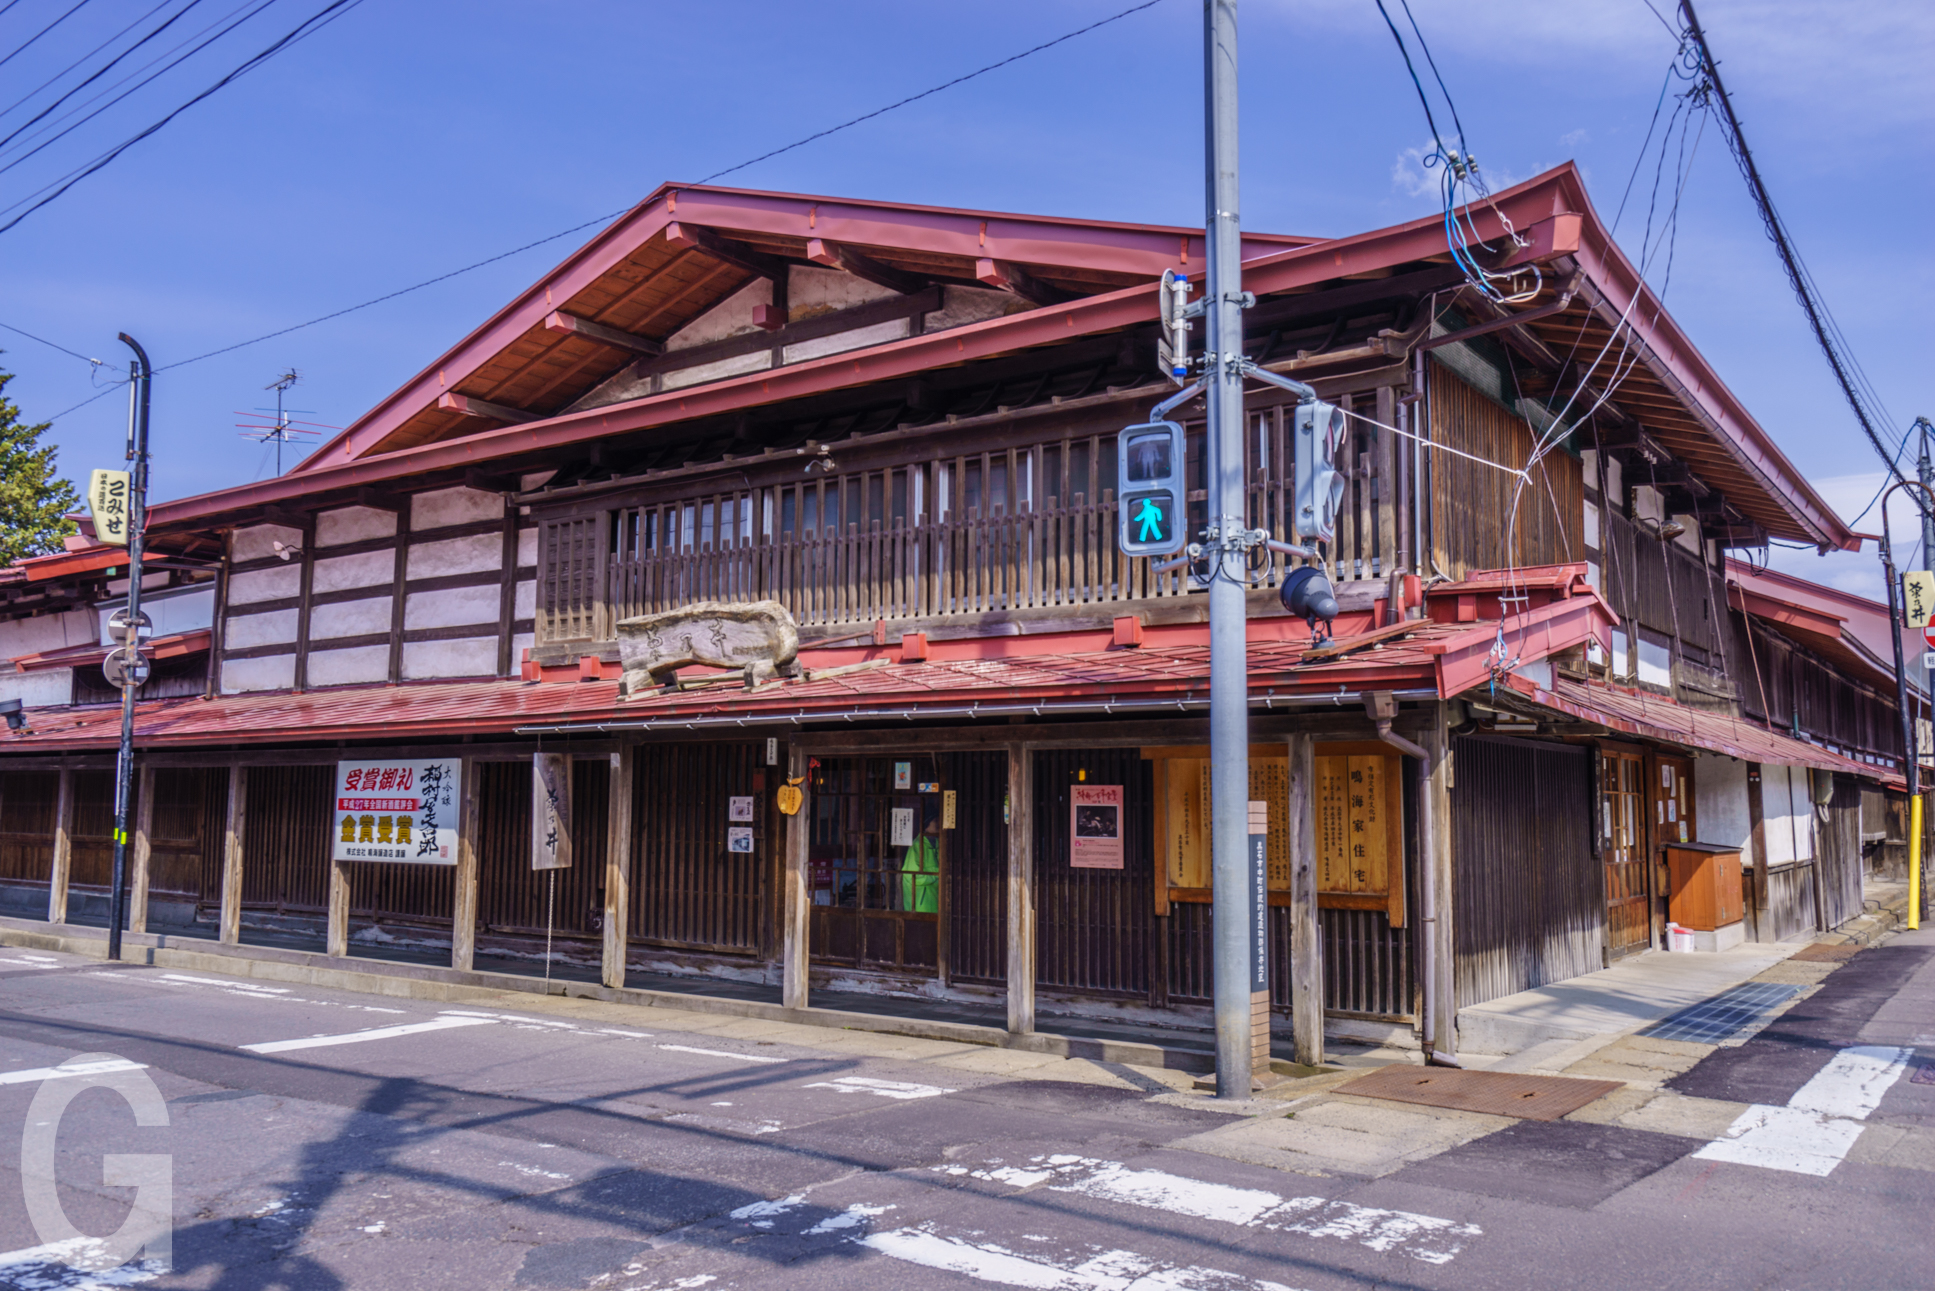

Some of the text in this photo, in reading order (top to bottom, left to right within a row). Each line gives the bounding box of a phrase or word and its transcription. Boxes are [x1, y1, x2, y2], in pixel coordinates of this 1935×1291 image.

[106, 480, 124, 535] こみせ
[1908, 581, 1926, 624] 菊乃井
[344, 767, 414, 791] 受賞御礼
[1367, 765, 1376, 823] 市指定有形文化財
[342, 799, 413, 811] 平成27年全国新酒鑑評会
[1351, 770, 1366, 883] 鳴海家住宅
[341, 814, 413, 844] 金賞受賞
